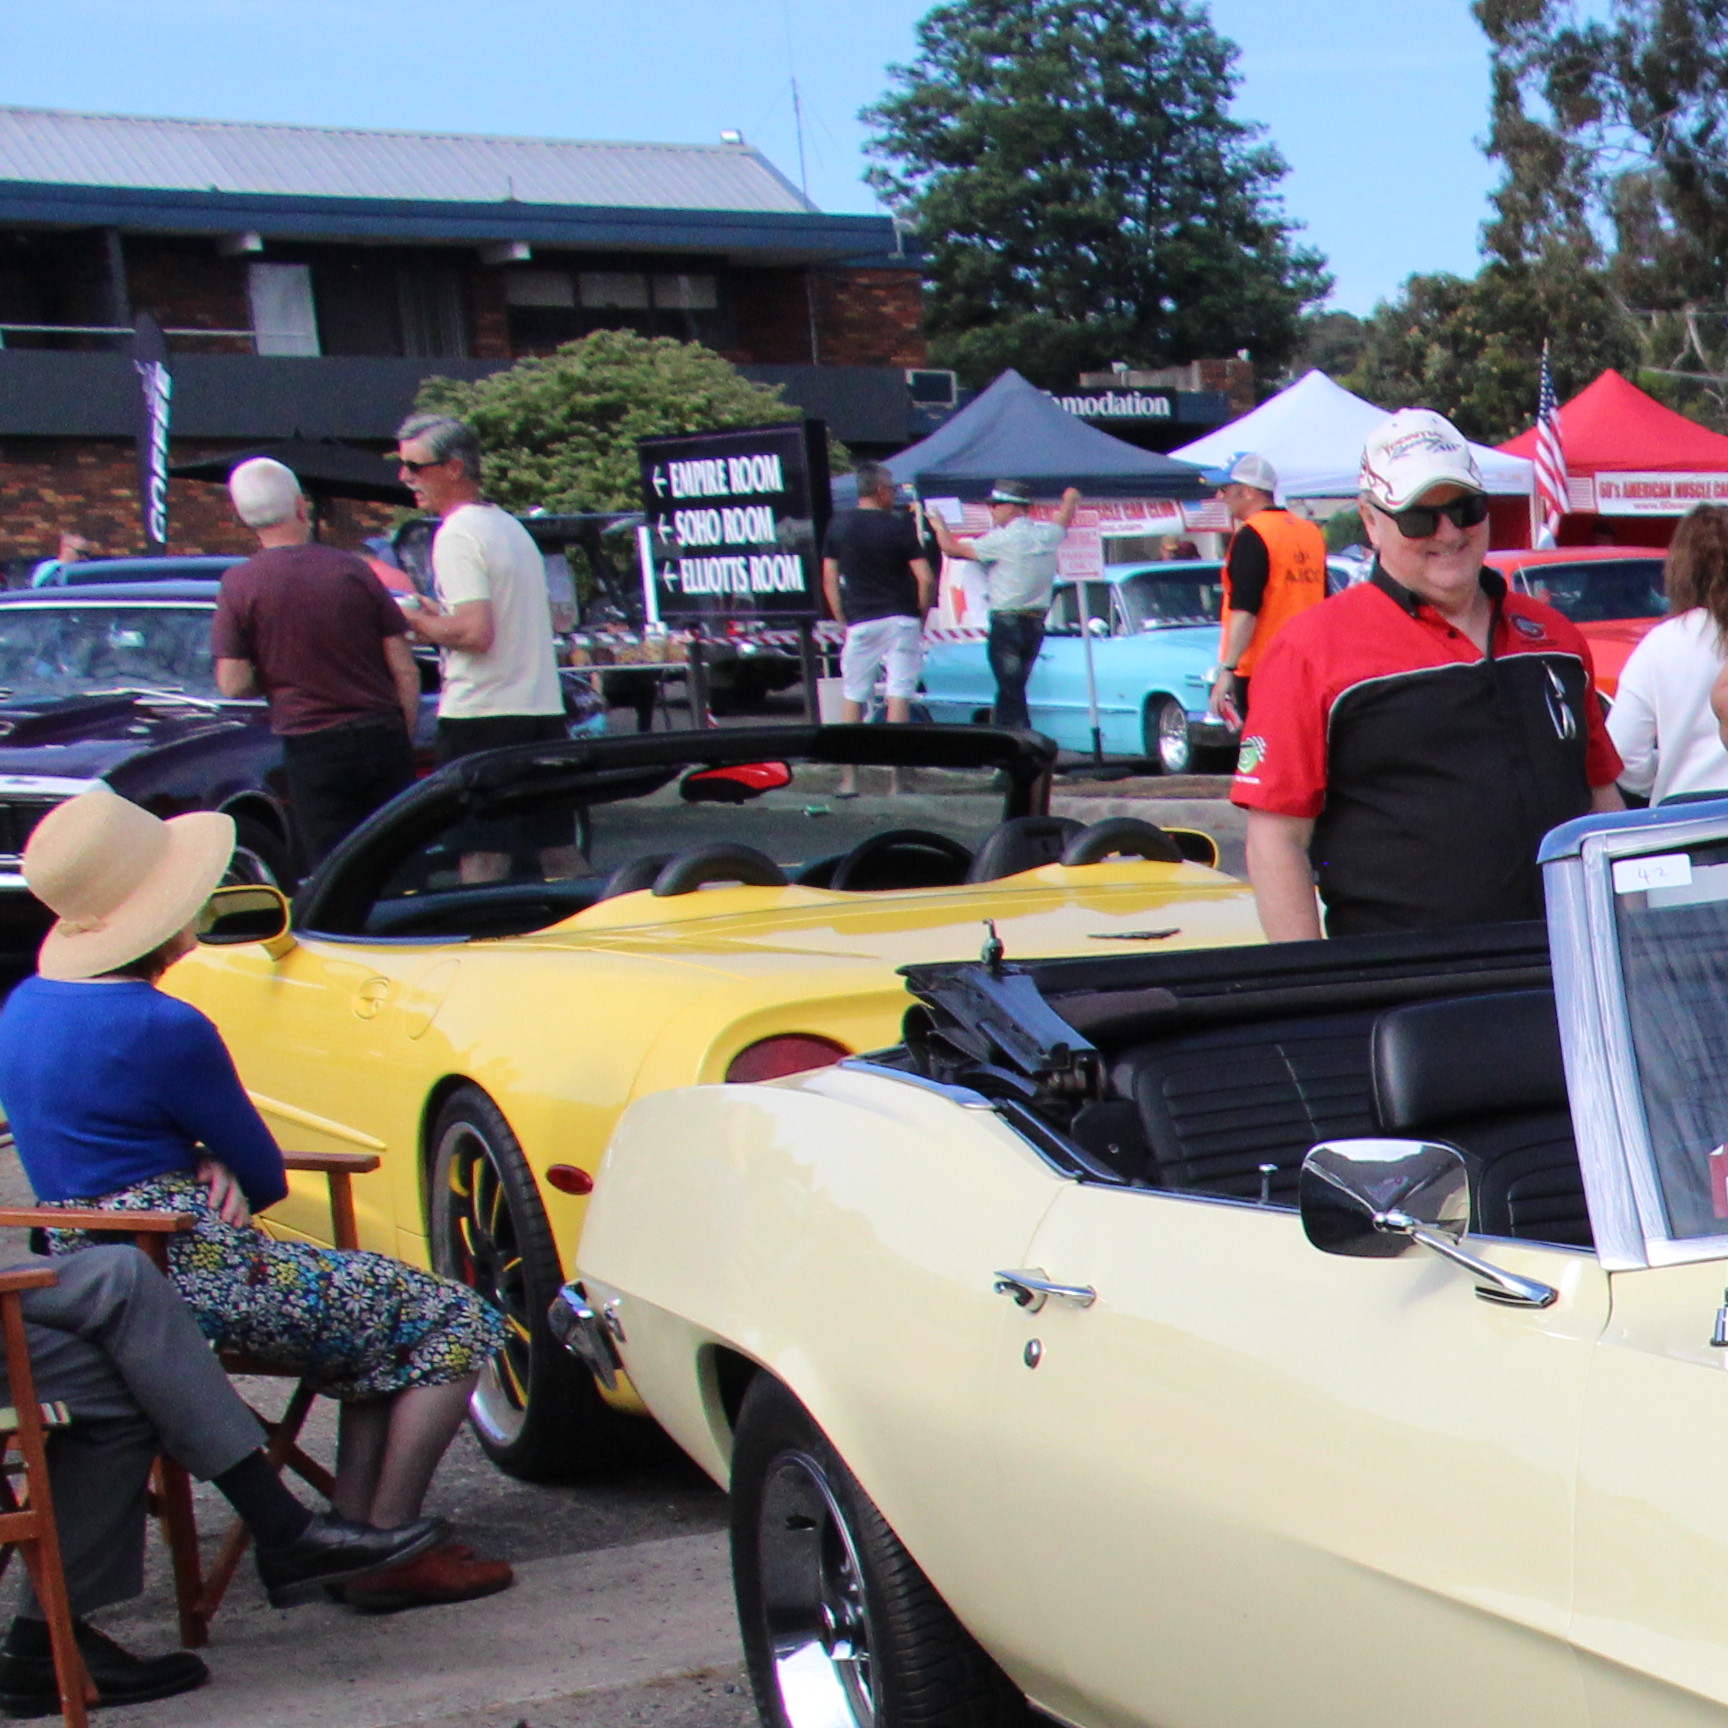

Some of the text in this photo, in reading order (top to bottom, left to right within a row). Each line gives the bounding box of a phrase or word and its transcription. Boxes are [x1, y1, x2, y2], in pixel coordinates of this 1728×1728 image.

[1050, 390, 1170, 416] modation
[668, 454, 784, 498] EMPIRE ROOM
[1623, 481, 1671, 498] AMERICAN
[1674, 481, 1711, 498] MUSCLE
[674, 506, 778, 546] SOHO ROOM
[679, 554, 807, 594] ELLIOTTS ROOM
